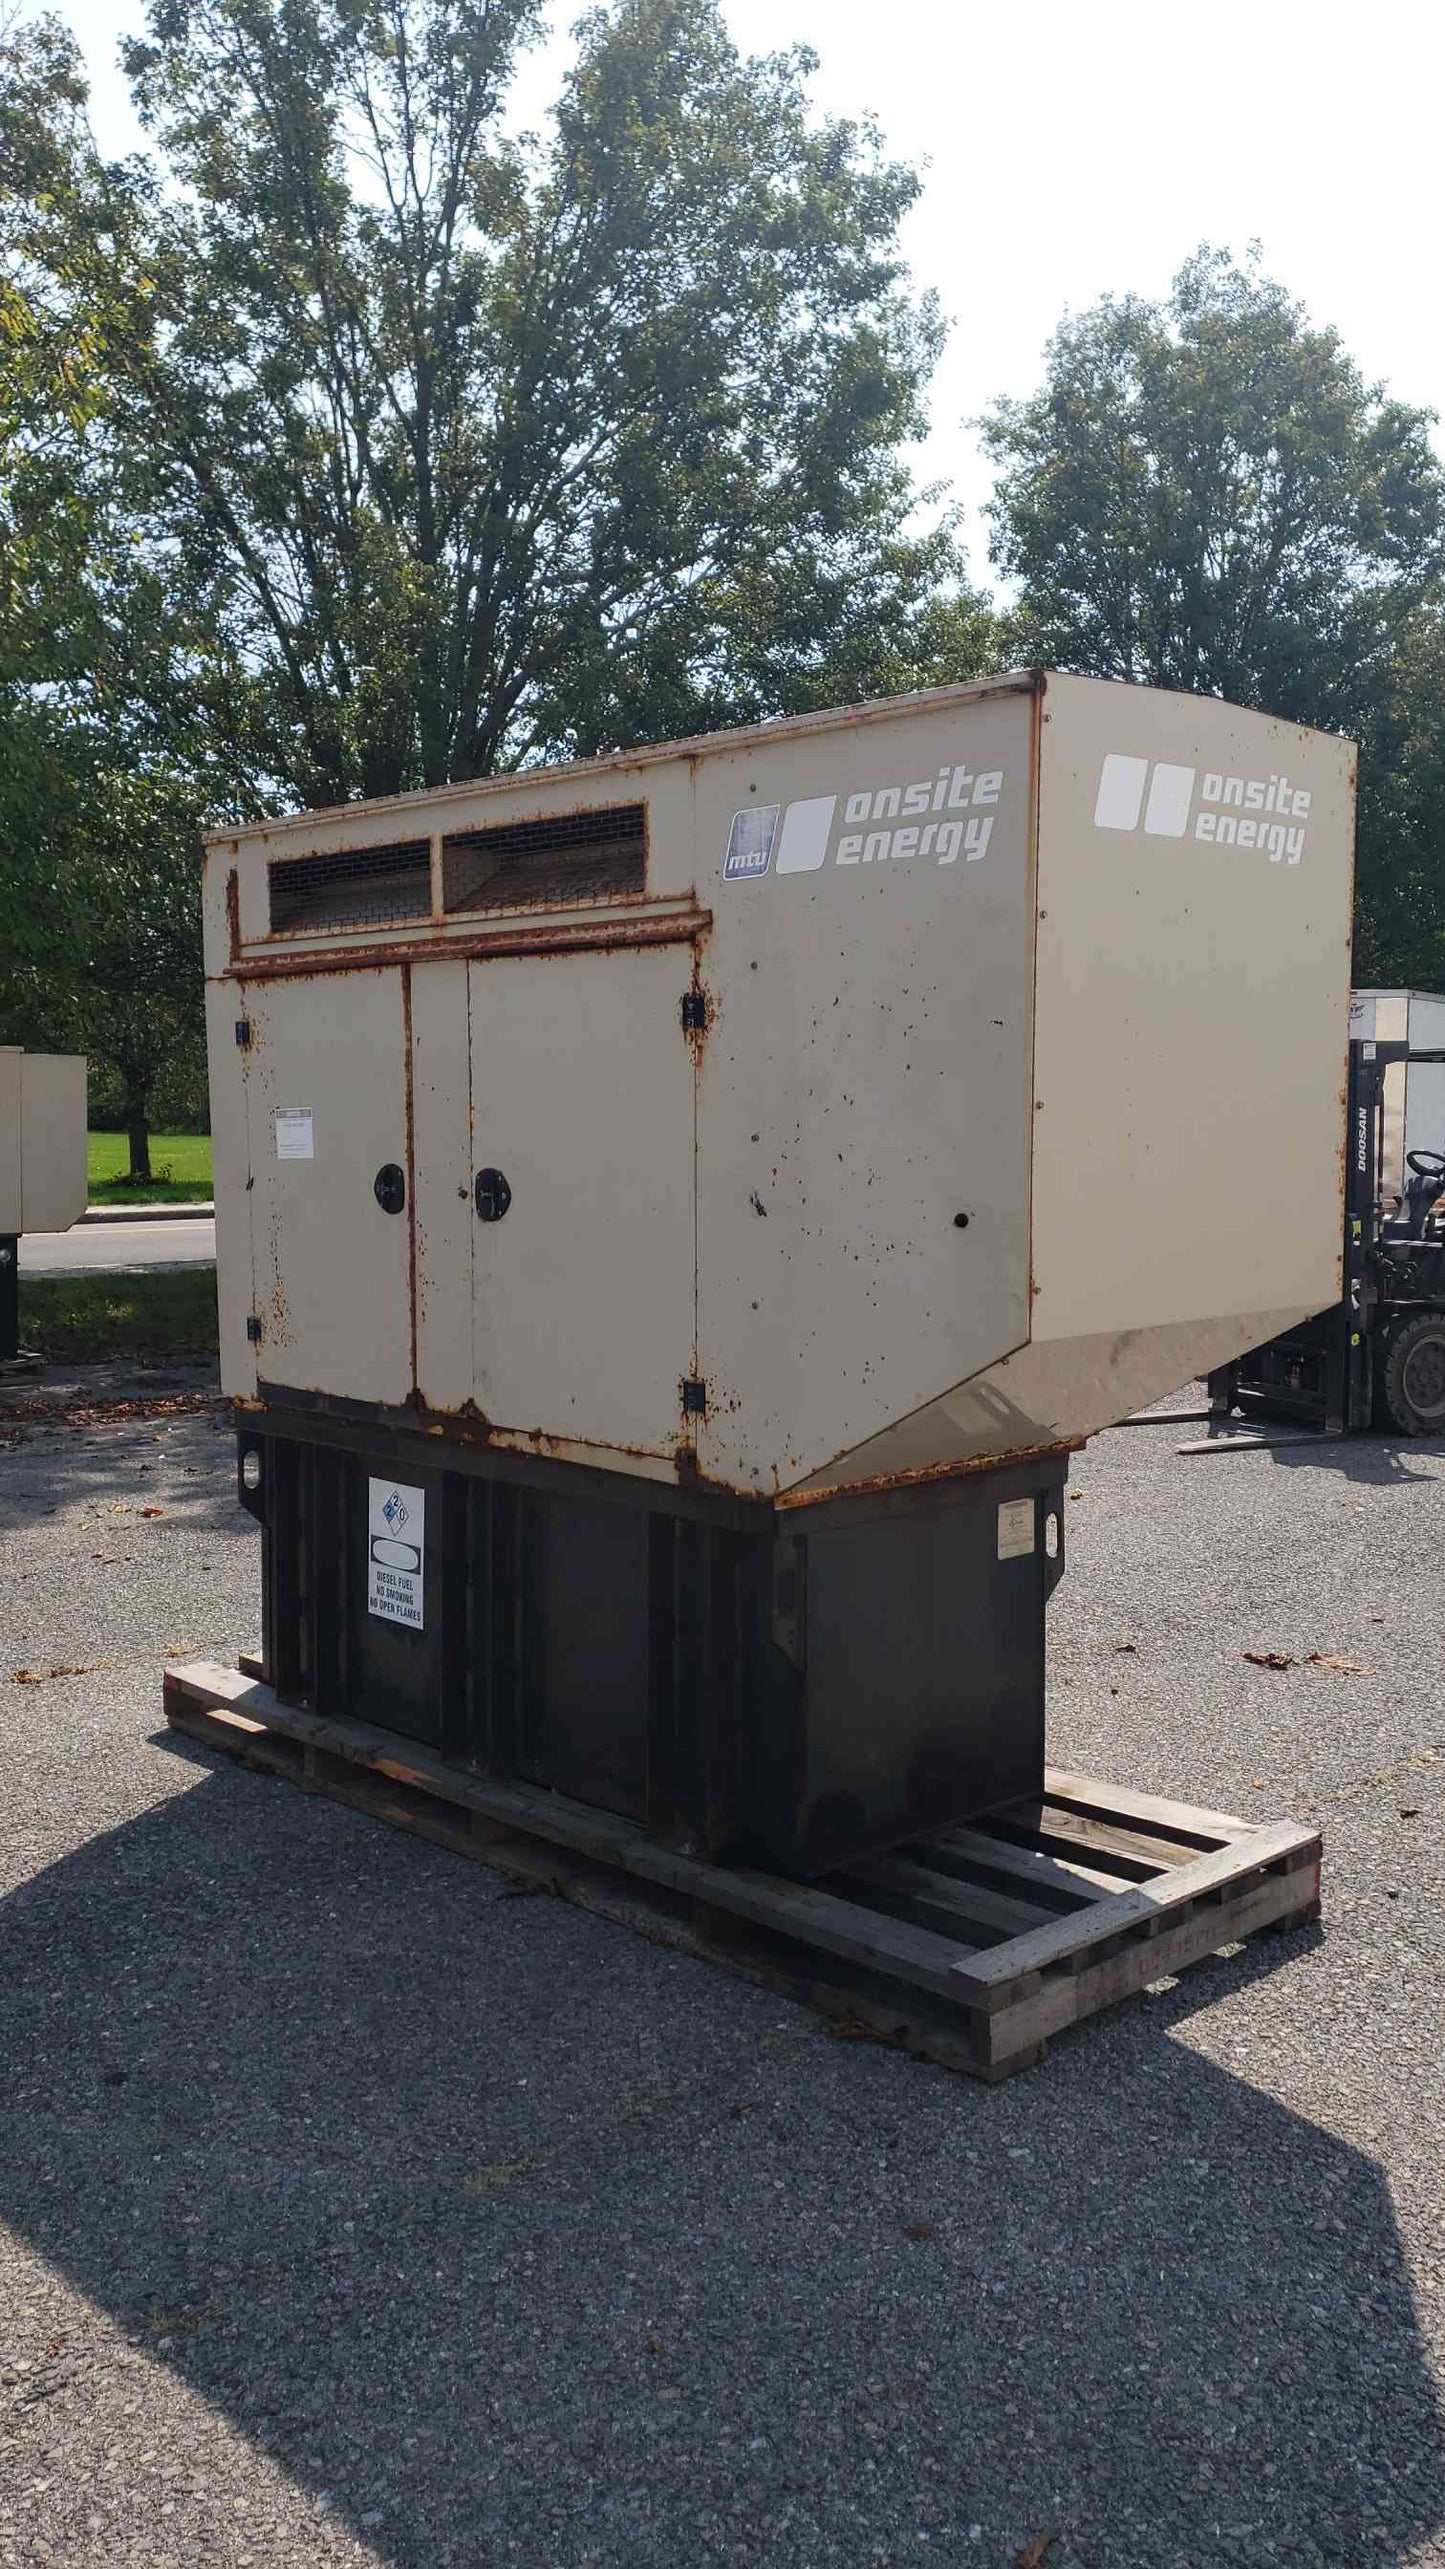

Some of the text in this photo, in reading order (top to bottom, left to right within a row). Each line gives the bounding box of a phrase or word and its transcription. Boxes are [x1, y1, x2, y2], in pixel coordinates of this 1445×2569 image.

[845, 765, 1004, 823] onsite
[1202, 773, 1311, 819] onsite
[836, 816, 994, 865] energy
[1195, 812, 1305, 865] energy
[728, 851, 768, 870] mtu
[1358, 1106, 1367, 1172] DOOSAN
[387, 1504, 392, 1517] 2
[393, 1494, 399, 1507] 2
[399, 1508, 405, 1521] 0
[376, 1570, 414, 1591] DIESEL FUEL
[376, 1584, 414, 1606] NO SMOKING
[370, 1597, 421, 1622] NO OPEN FLAMES
